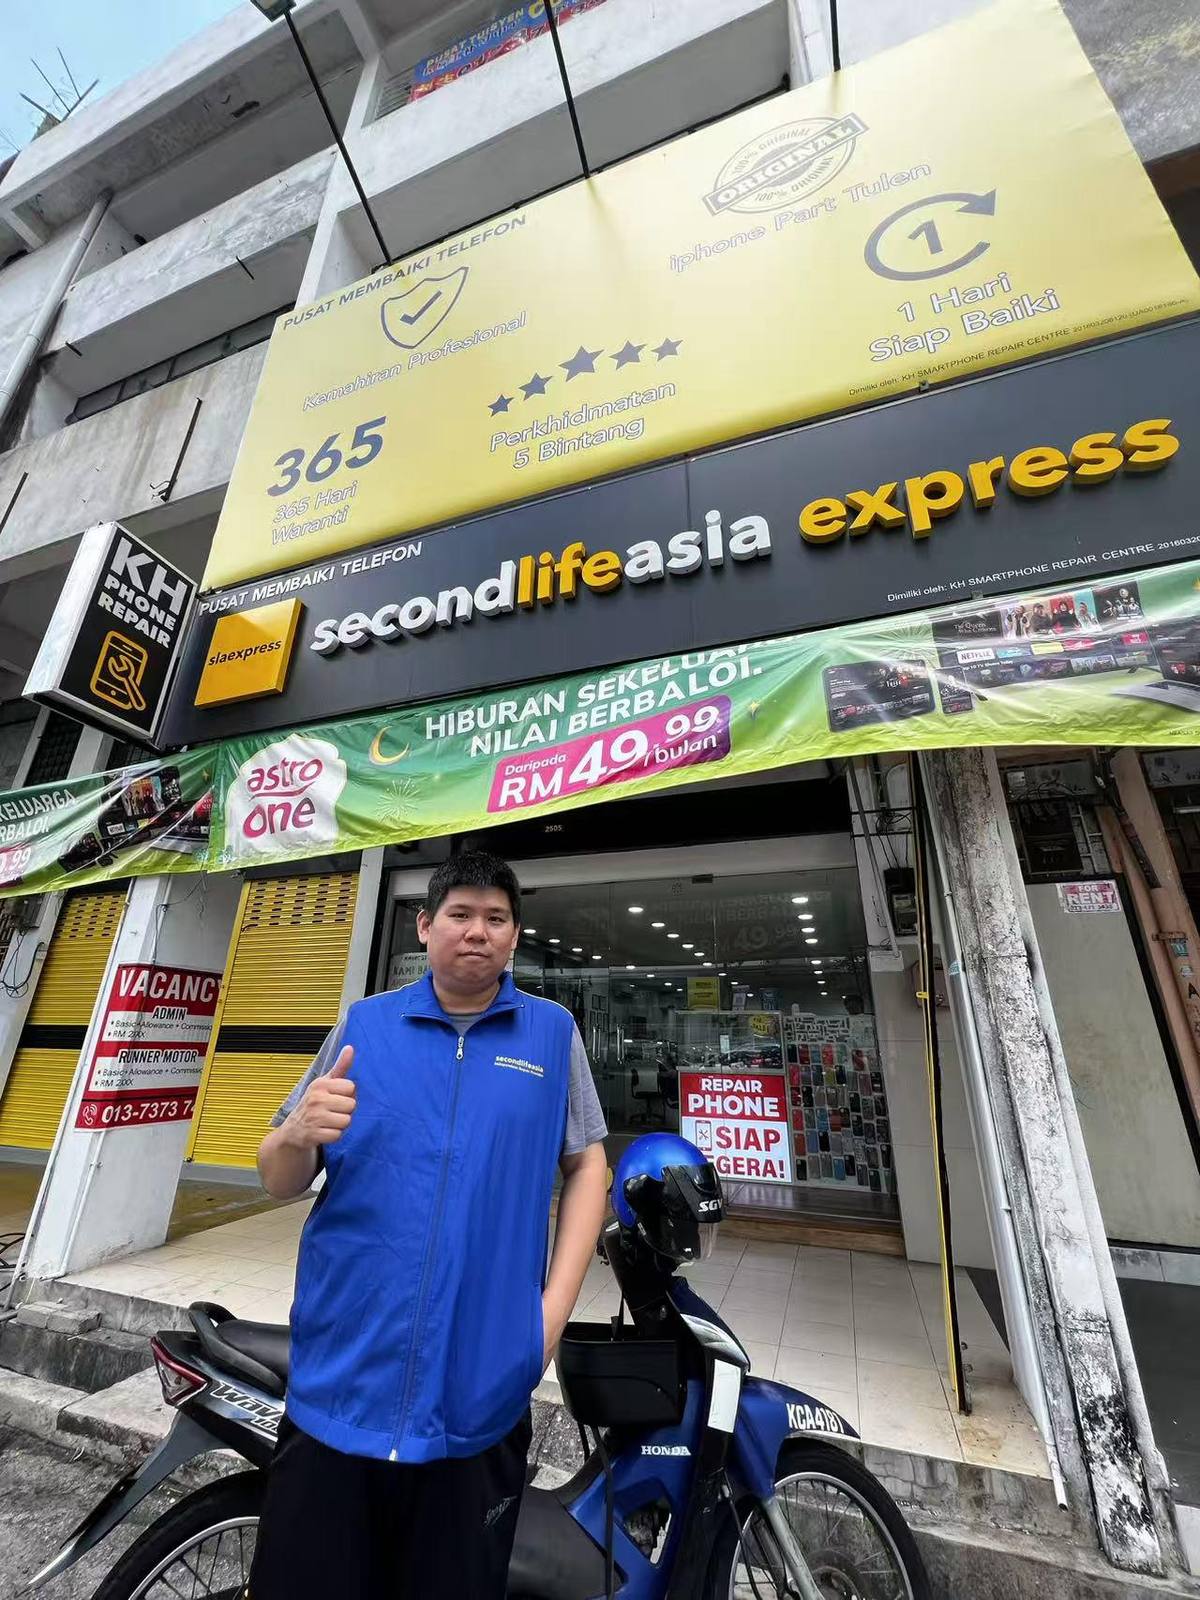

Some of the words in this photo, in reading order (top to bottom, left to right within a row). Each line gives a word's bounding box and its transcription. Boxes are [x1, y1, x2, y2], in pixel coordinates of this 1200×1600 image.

[717, 126, 852, 203] ORIGINAL
[773, 195, 837, 232] Part
[843, 163, 932, 205] Tulen
[907, 220, 943, 256] 1
[282, 299, 335, 331] PUSAT
[338, 259, 431, 307] MEMBAIKI
[436, 214, 527, 263] TELEFON
[896, 301, 915, 323] 1
[930, 271, 1011, 315] Hari
[868, 326, 951, 362] Siap
[964, 288, 1061, 337] Baiki
[302, 363, 402, 412] Kemahiran
[408, 311, 528, 370] Profesional
[917, 352, 986, 377] SMARTPHONE
[987, 340, 1025, 359] REPAIR
[1026, 327, 1072, 346] CENTRE
[489, 381, 677, 453] Perkhidmatan
[267, 416, 388, 498] 365
[513, 448, 531, 471] 5
[538, 417, 645, 463] Bintang
[272, 496, 309, 524] 365
[315, 481, 359, 511] Hari
[272, 505, 349, 545] Waranti
[309, 509, 773, 656] secondlifeasia
[799, 418, 1180, 542] express
[110, 537, 188, 616] KH
[199, 591, 249, 617] PUSAT
[252, 566, 335, 602] MEMBAIKI
[341, 541, 424, 577] TELEFON
[887, 587, 921, 602] Dimiliki
[923, 584, 948, 597] oleh:
[949, 579, 966, 591] KH
[968, 564, 1049, 587] SMARTPHONE
[1052, 554, 1098, 571] REPAIR
[1102, 543, 1155, 562] CENTRE
[97, 592, 171, 649] REPAIR
[104, 573, 177, 632] PHONE
[208, 640, 282, 666] slaexpress
[961, 650, 992, 661] NETFLIX
[425, 690, 566, 740] HIBURAN
[470, 720, 557, 758] NILAI
[567, 656, 765, 737] BERBALOI.
[248, 757, 323, 792] astro
[498, 769, 563, 808] RM
[568, 729, 649, 785] 49
[504, 753, 568, 777] Daripada
[242, 797, 317, 840] one
[1066, 891, 1114, 905] RENT
[1078, 884, 1099, 892] FOR
[112, 1030, 126, 1038] RM
[140, 1021, 174, 1029] Allowance
[152, 1007, 188, 1021] ADMIN
[118, 1050, 160, 1065] RUNNER
[162, 1050, 198, 1064] MOTOR
[129, 1067, 163, 1076] Allowance
[495, 1055, 544, 1073] secondlifeasia
[100, 1079, 113, 1087] RM
[701, 1078, 762, 1093] REPAIR
[101, 1101, 179, 1124] 013-7373
[688, 1093, 780, 1117] PHONE
[715, 1125, 781, 1152] SIAP
[705, 1154, 785, 1179] GERA!
[785, 1402, 845, 1434] KCA4181
[641, 1445, 691, 1456] HONDA
